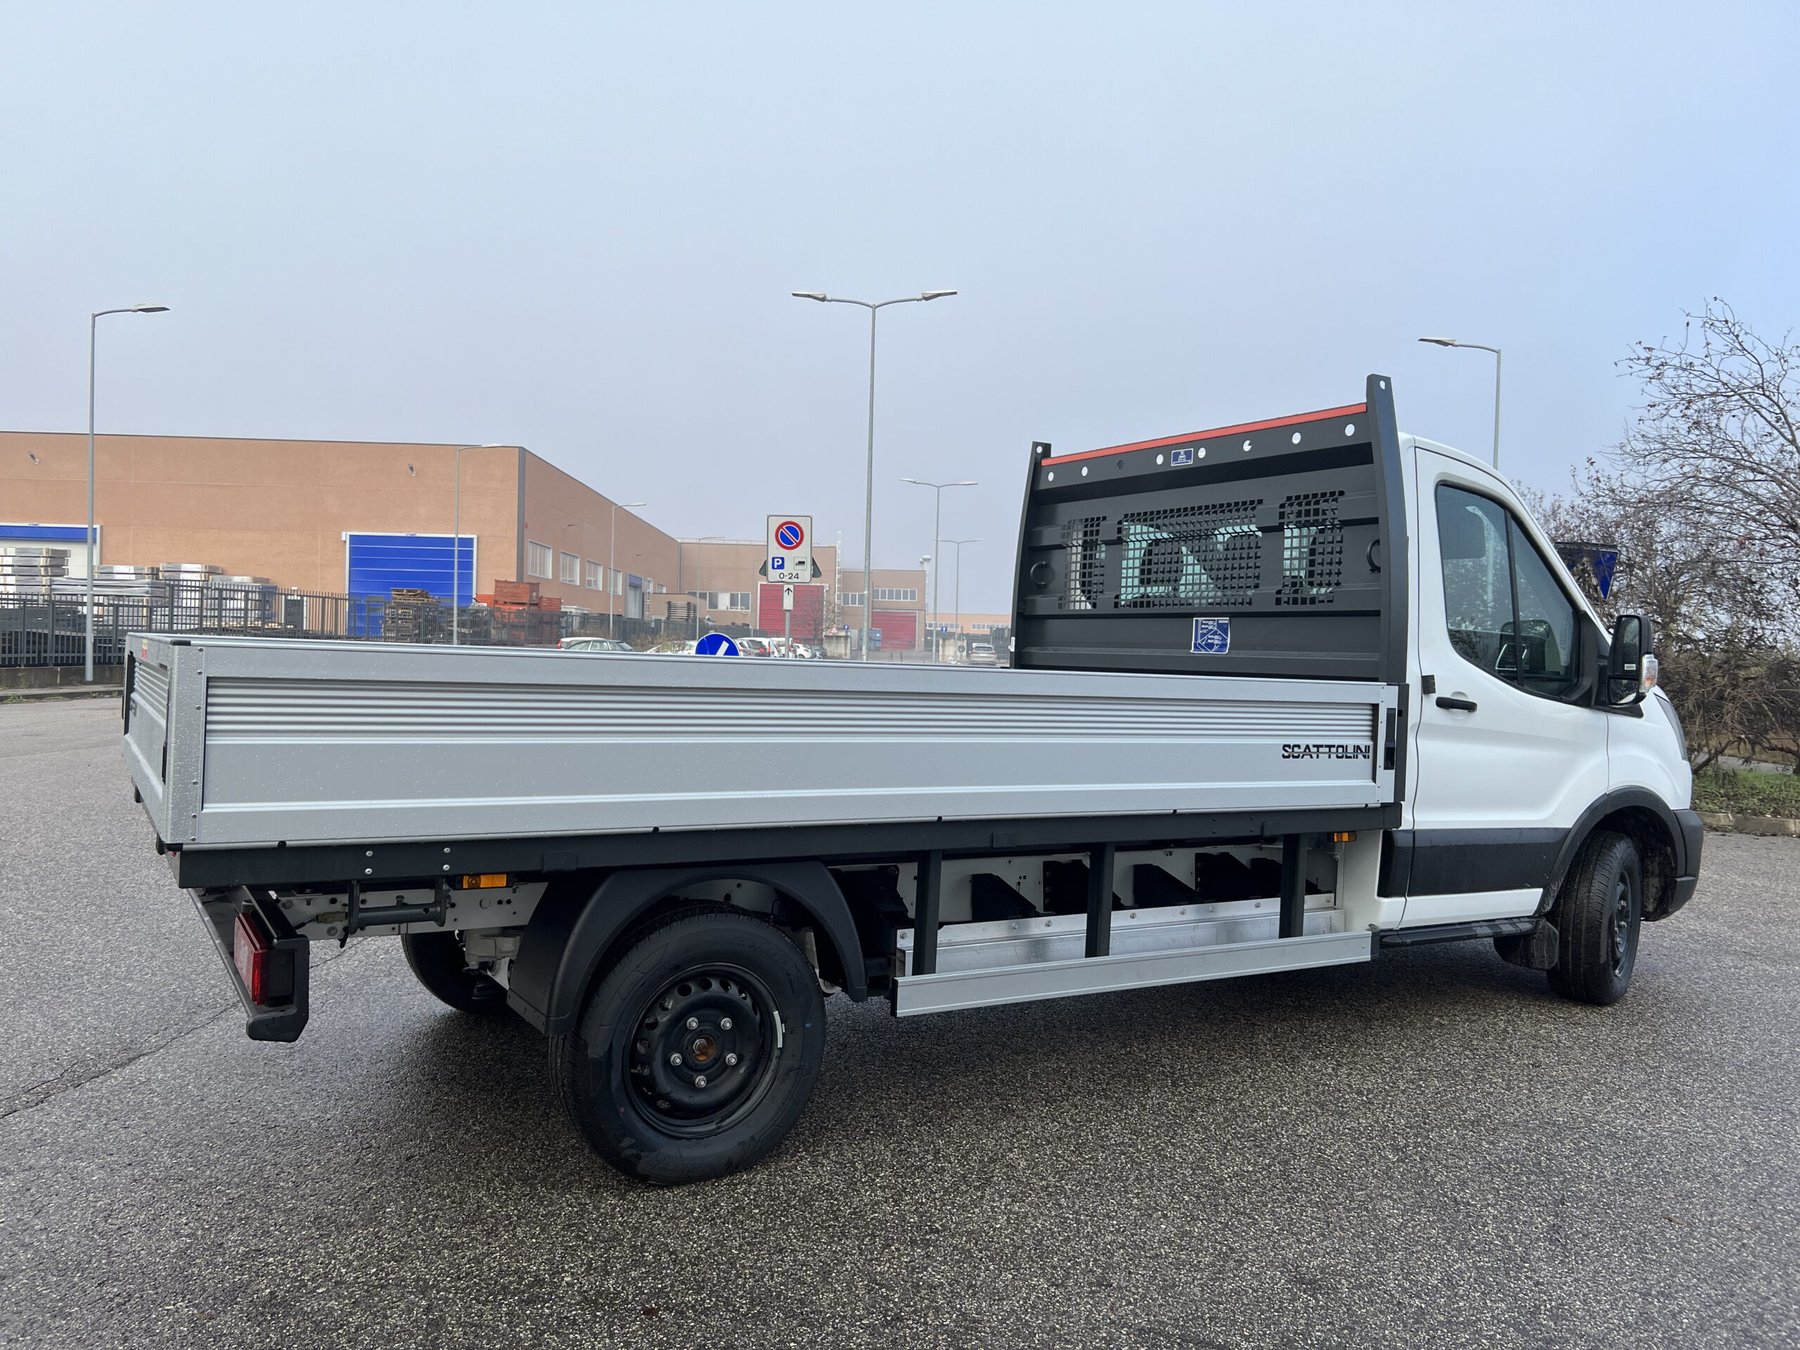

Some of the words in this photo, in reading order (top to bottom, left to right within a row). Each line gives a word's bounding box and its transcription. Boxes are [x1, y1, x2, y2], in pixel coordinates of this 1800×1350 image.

[773, 558, 783, 569] P
[778, 572, 800, 580] 0-24
[1281, 744, 1371, 760] SCATTOLINI
